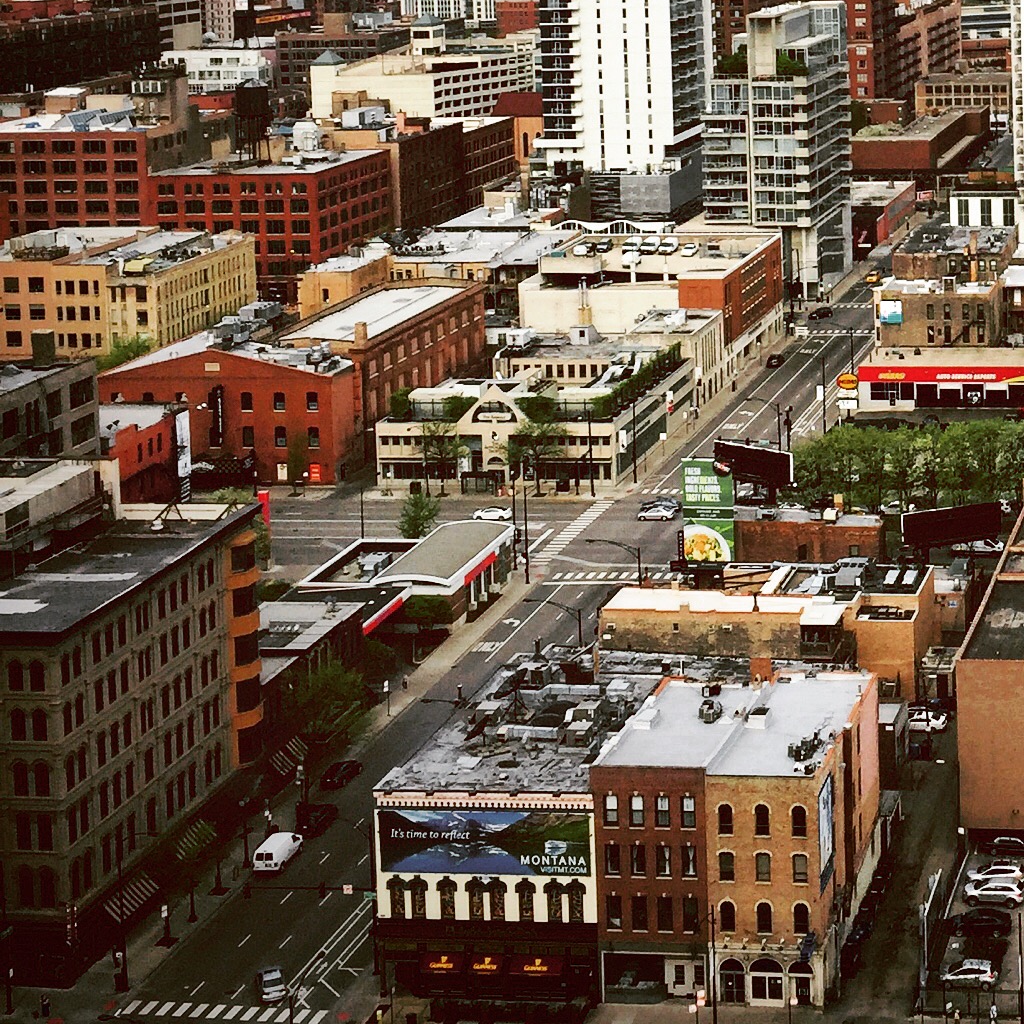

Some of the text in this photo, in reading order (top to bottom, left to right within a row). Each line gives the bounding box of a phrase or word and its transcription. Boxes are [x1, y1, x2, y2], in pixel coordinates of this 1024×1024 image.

[390, 828, 471, 841] It's time to reflect
[520, 854, 587, 866] MONTANA
[540, 865, 588, 874] VISITMT.COM
